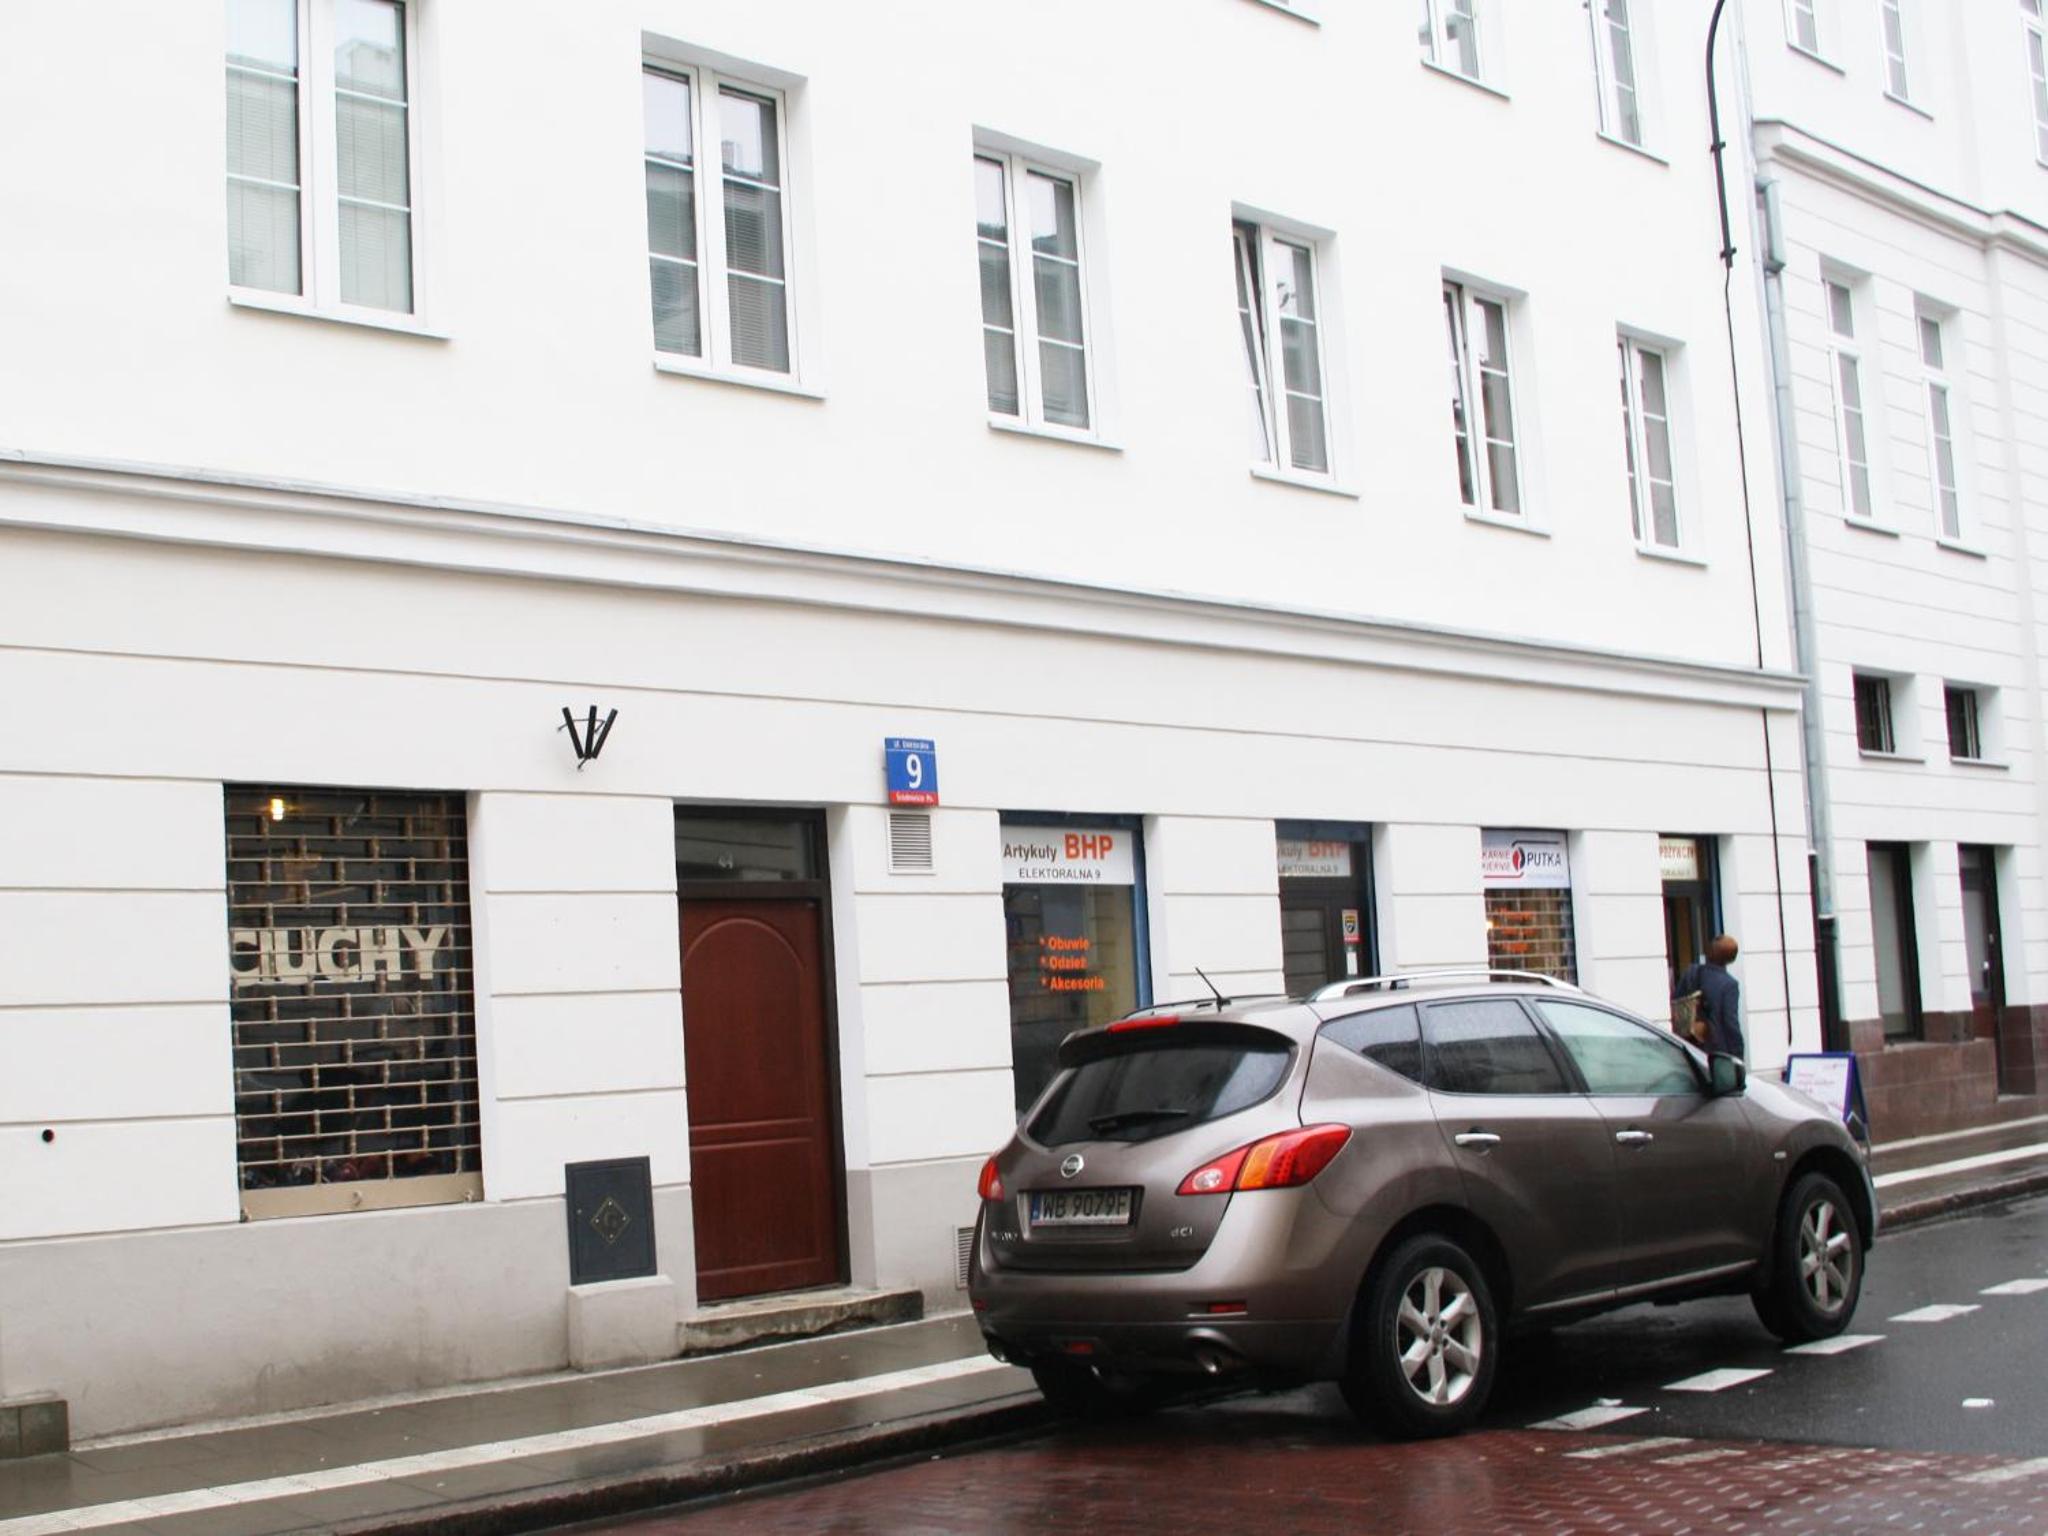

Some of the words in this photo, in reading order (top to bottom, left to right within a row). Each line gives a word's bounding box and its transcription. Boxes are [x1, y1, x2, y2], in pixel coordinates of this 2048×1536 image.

[906, 753, 922, 789] 9
[1003, 843, 1057, 862] Artykuły
[1064, 832, 1113, 860] BHP
[1527, 851, 1562, 866] PUTKA
[1019, 867, 1092, 879] ELEKTORALNA
[1049, 936, 1090, 951] Obuwie
[229, 928, 447, 986] CIUCHY
[1051, 976, 1104, 991] Akcesoria
[1043, 1193, 1066, 1218] WB
